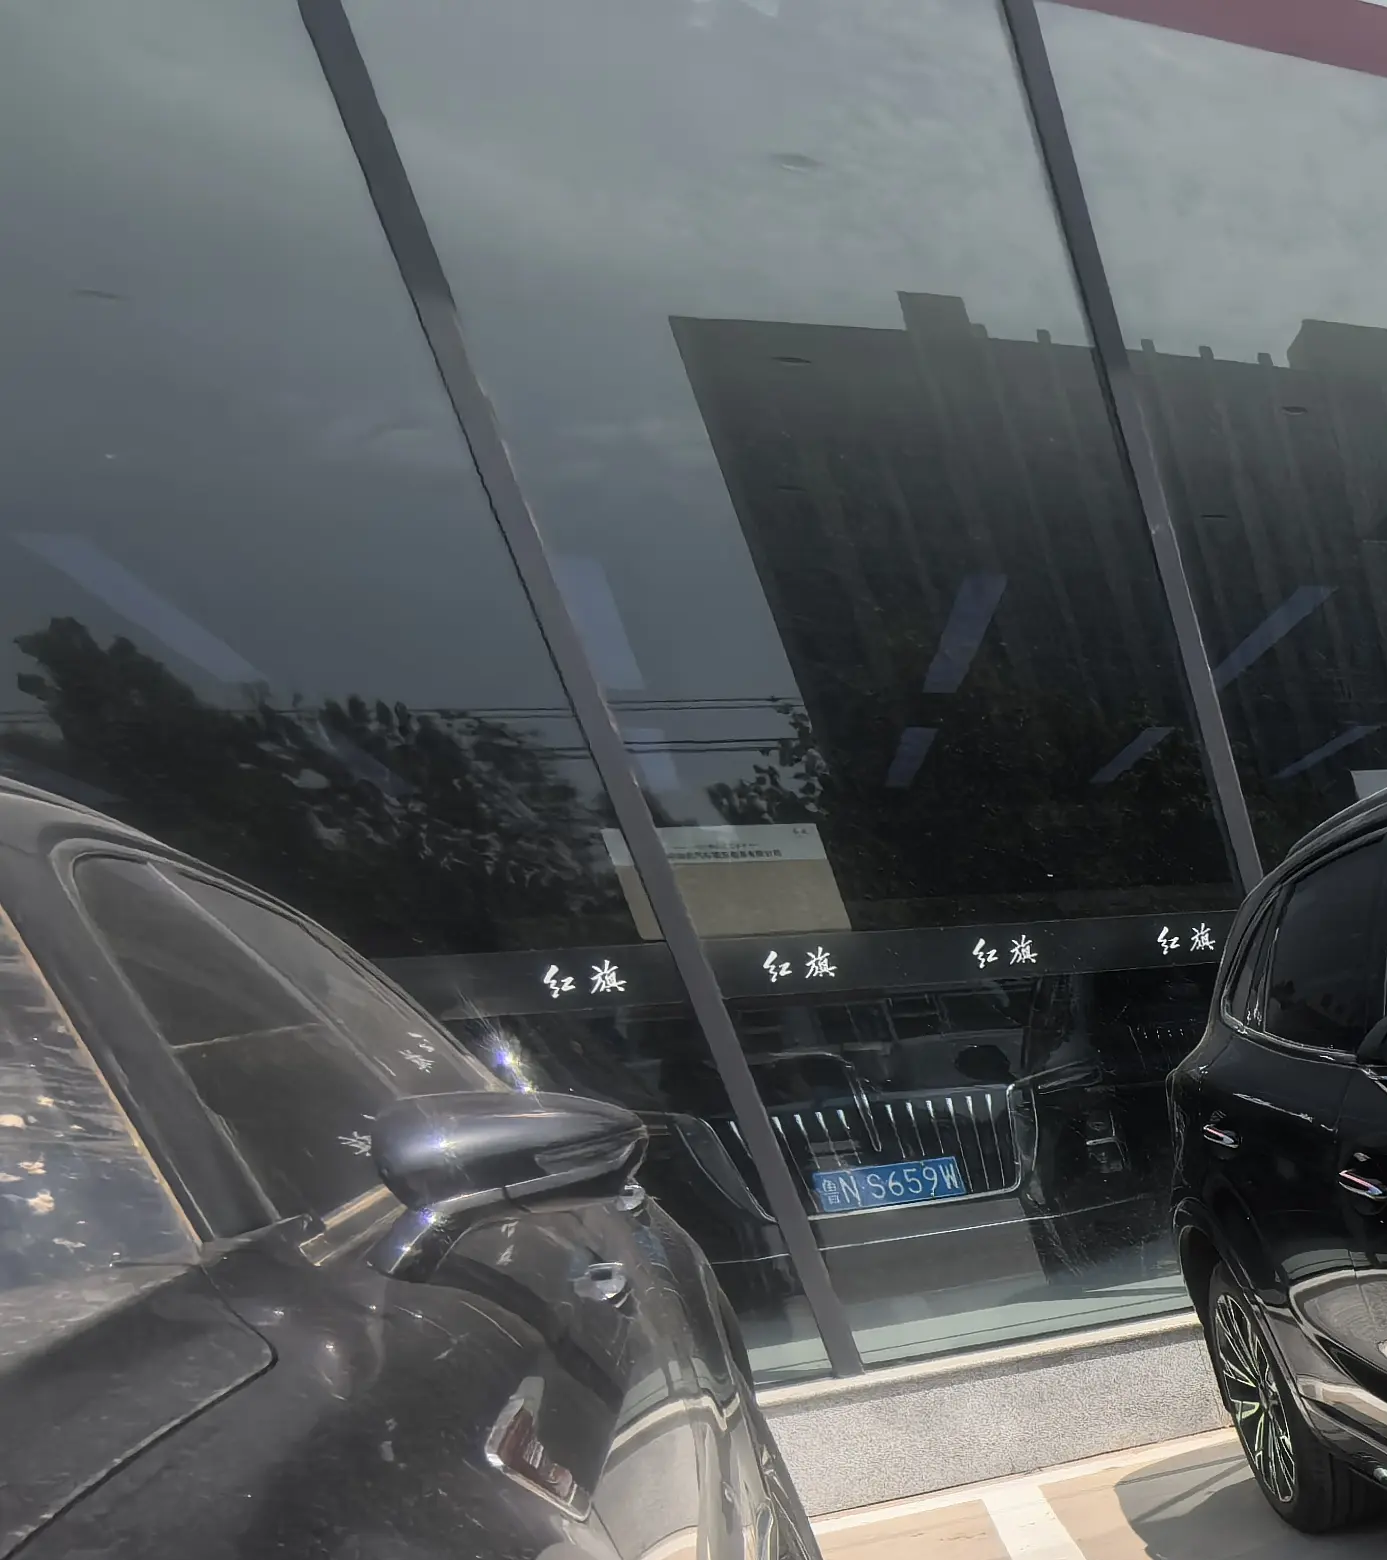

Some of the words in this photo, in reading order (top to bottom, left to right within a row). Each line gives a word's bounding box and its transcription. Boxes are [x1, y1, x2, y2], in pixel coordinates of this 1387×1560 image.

[543, 959, 627, 999] 红旗
[762, 946, 838, 983] 红旗
[972, 934, 1038, 969] 红旗
[1157, 922, 1216, 956] 红旗
